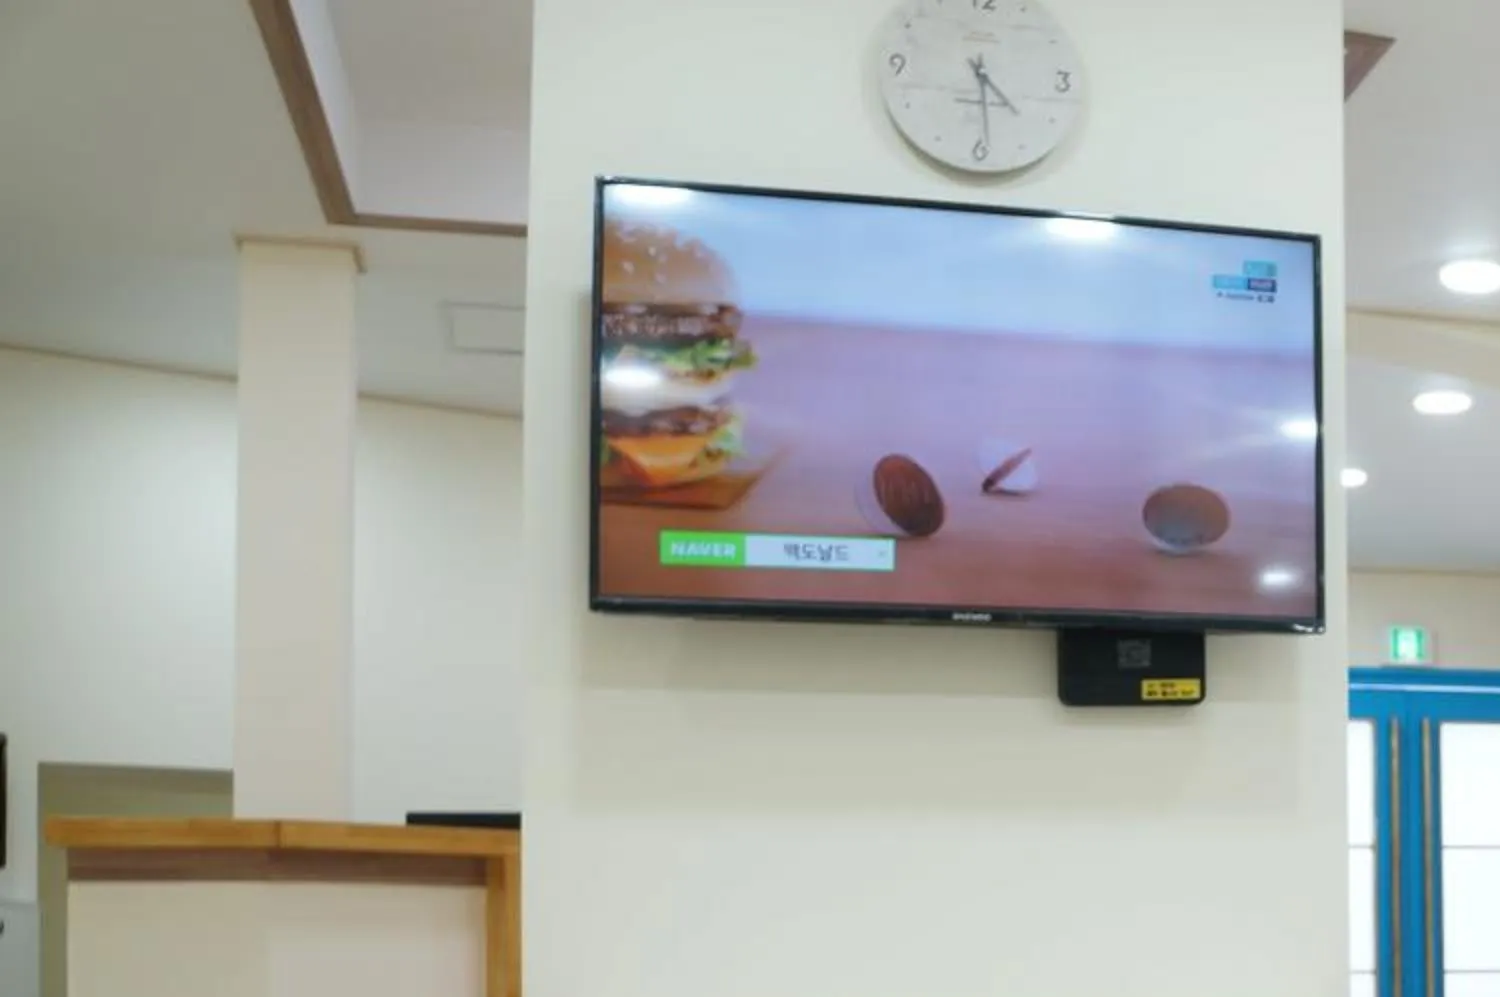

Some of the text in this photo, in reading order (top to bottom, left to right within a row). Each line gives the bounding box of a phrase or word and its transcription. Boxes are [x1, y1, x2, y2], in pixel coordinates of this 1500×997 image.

[889, 53, 906, 76] 9
[1055, 70, 1071, 93] 3
[972, 137, 989, 161] 6
[670, 542, 737, 560] NAVER
